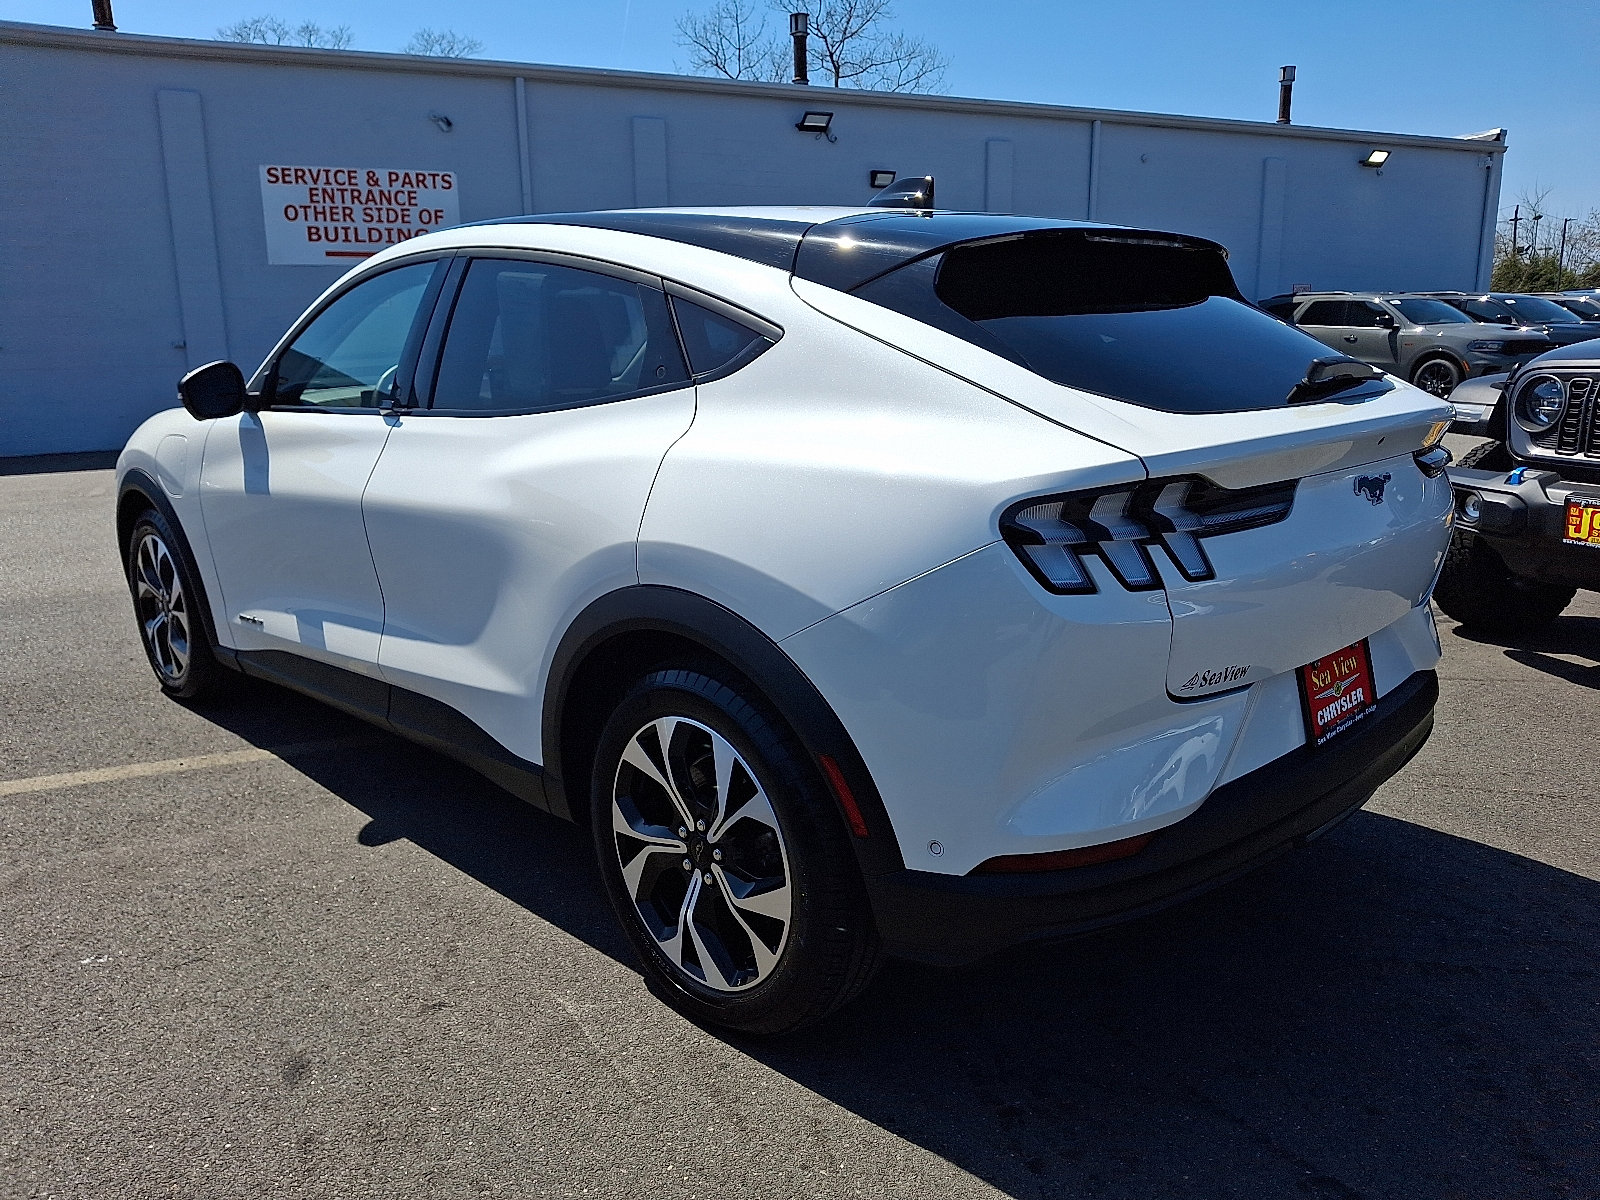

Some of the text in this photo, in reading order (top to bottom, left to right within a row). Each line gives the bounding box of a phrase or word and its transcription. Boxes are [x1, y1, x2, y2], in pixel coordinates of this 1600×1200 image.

[266, 167, 453, 190] SERVICE & PARTS
[308, 187, 419, 207] ENTRANCE
[283, 204, 444, 225] OTHER SIDE OF
[1311, 656, 1358, 691] Sea View
[1317, 687, 1364, 726] CHRYSLER
